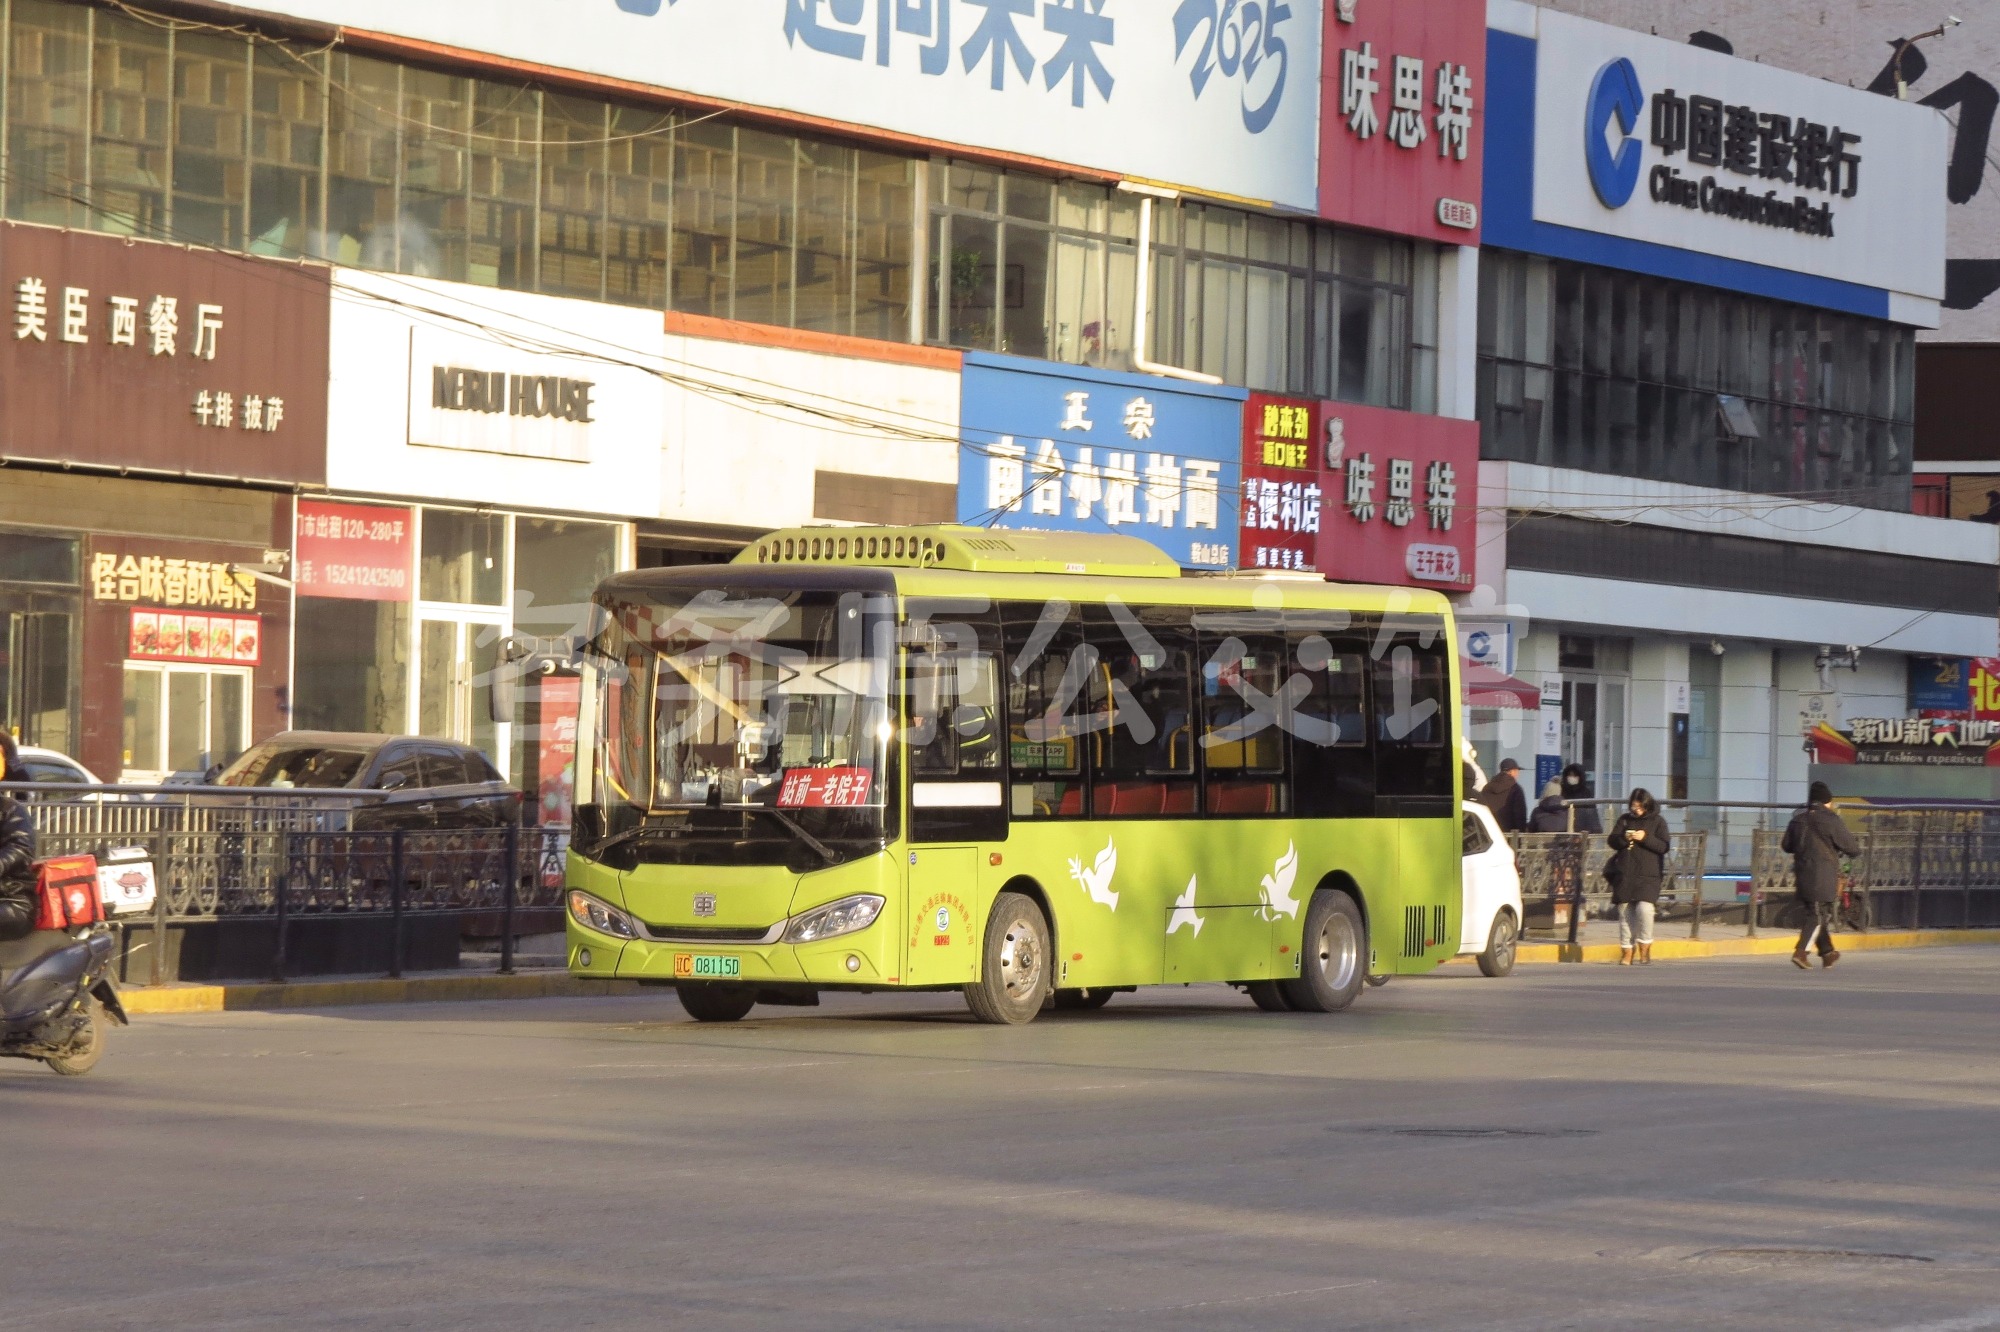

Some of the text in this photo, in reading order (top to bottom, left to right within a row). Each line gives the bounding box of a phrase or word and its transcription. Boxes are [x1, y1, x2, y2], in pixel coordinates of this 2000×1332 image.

[1339, 41, 1474, 161] 味思特
[1651, 88, 1862, 198] 中国建设银行
[15, 276, 224, 360] 美臣西餐厅
[196, 389, 284, 432] 牛排 披萨
[509, 374, 596, 424] HOUSE
[1060, 391, 1156, 440] 正宗
[1258, 479, 1322, 533] 便利店
[1347, 453, 1457, 531] 味思特
[676, 957, 739, 975] 辽C 08115D
